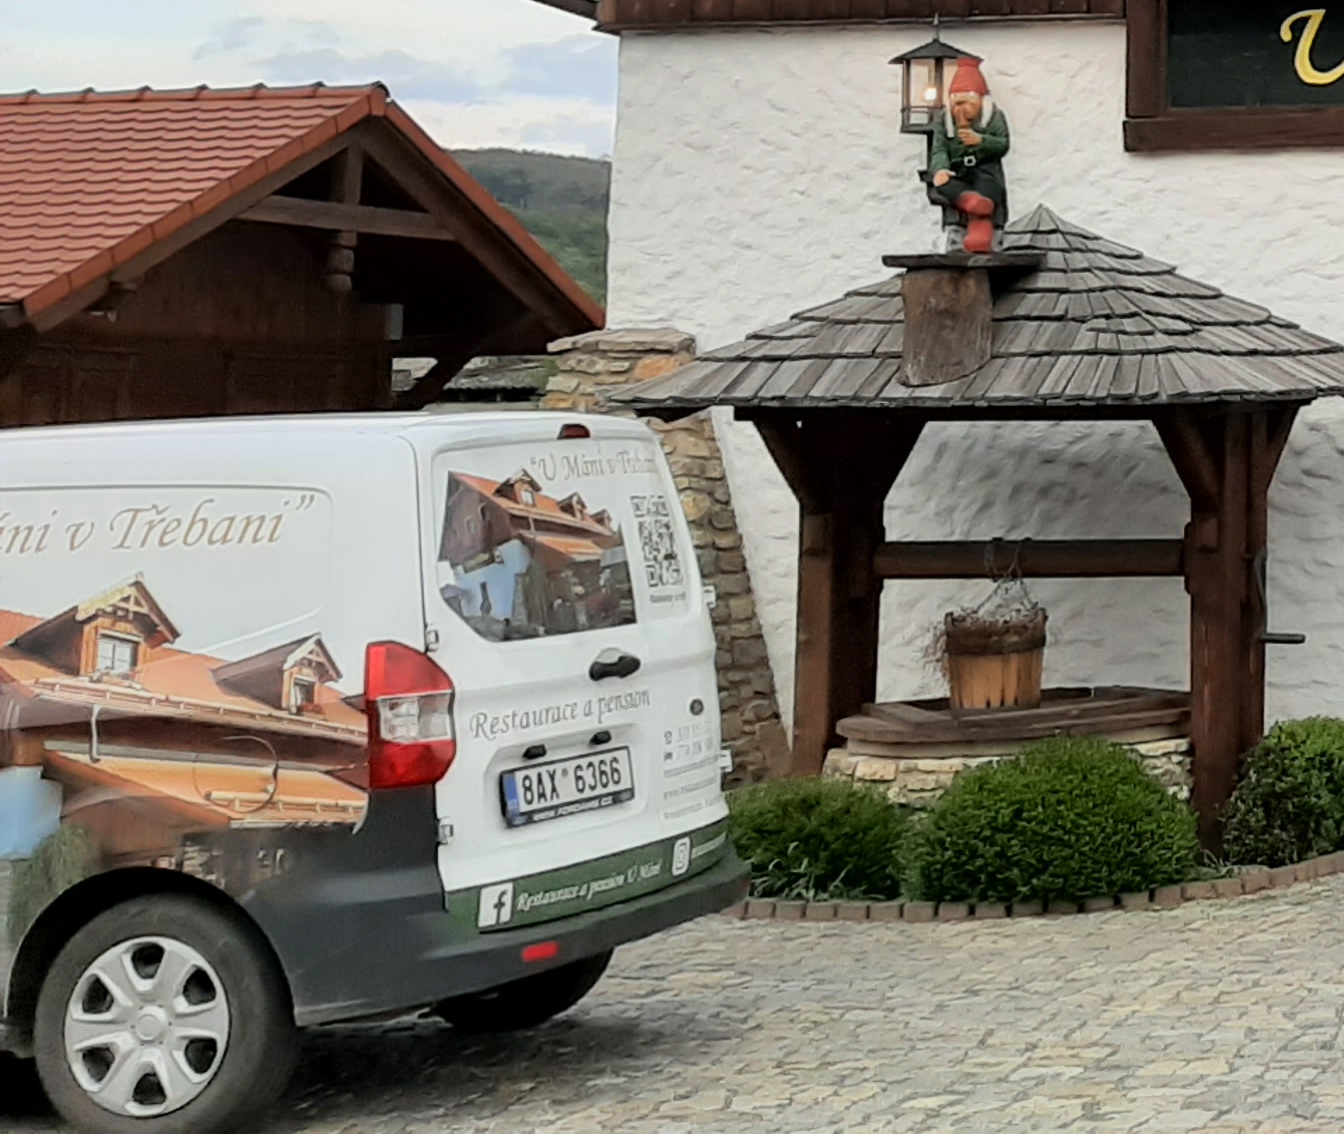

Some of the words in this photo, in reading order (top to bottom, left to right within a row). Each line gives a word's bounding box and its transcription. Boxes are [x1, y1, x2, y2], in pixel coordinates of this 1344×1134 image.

[0, 509, 58, 554] ni
[65, 521, 95, 552] v
[469, 701, 579, 740] Restaurace
[583, 702, 594, 717] a
[598, 689, 651, 725] pension
[573, 756, 622, 794] 6366
